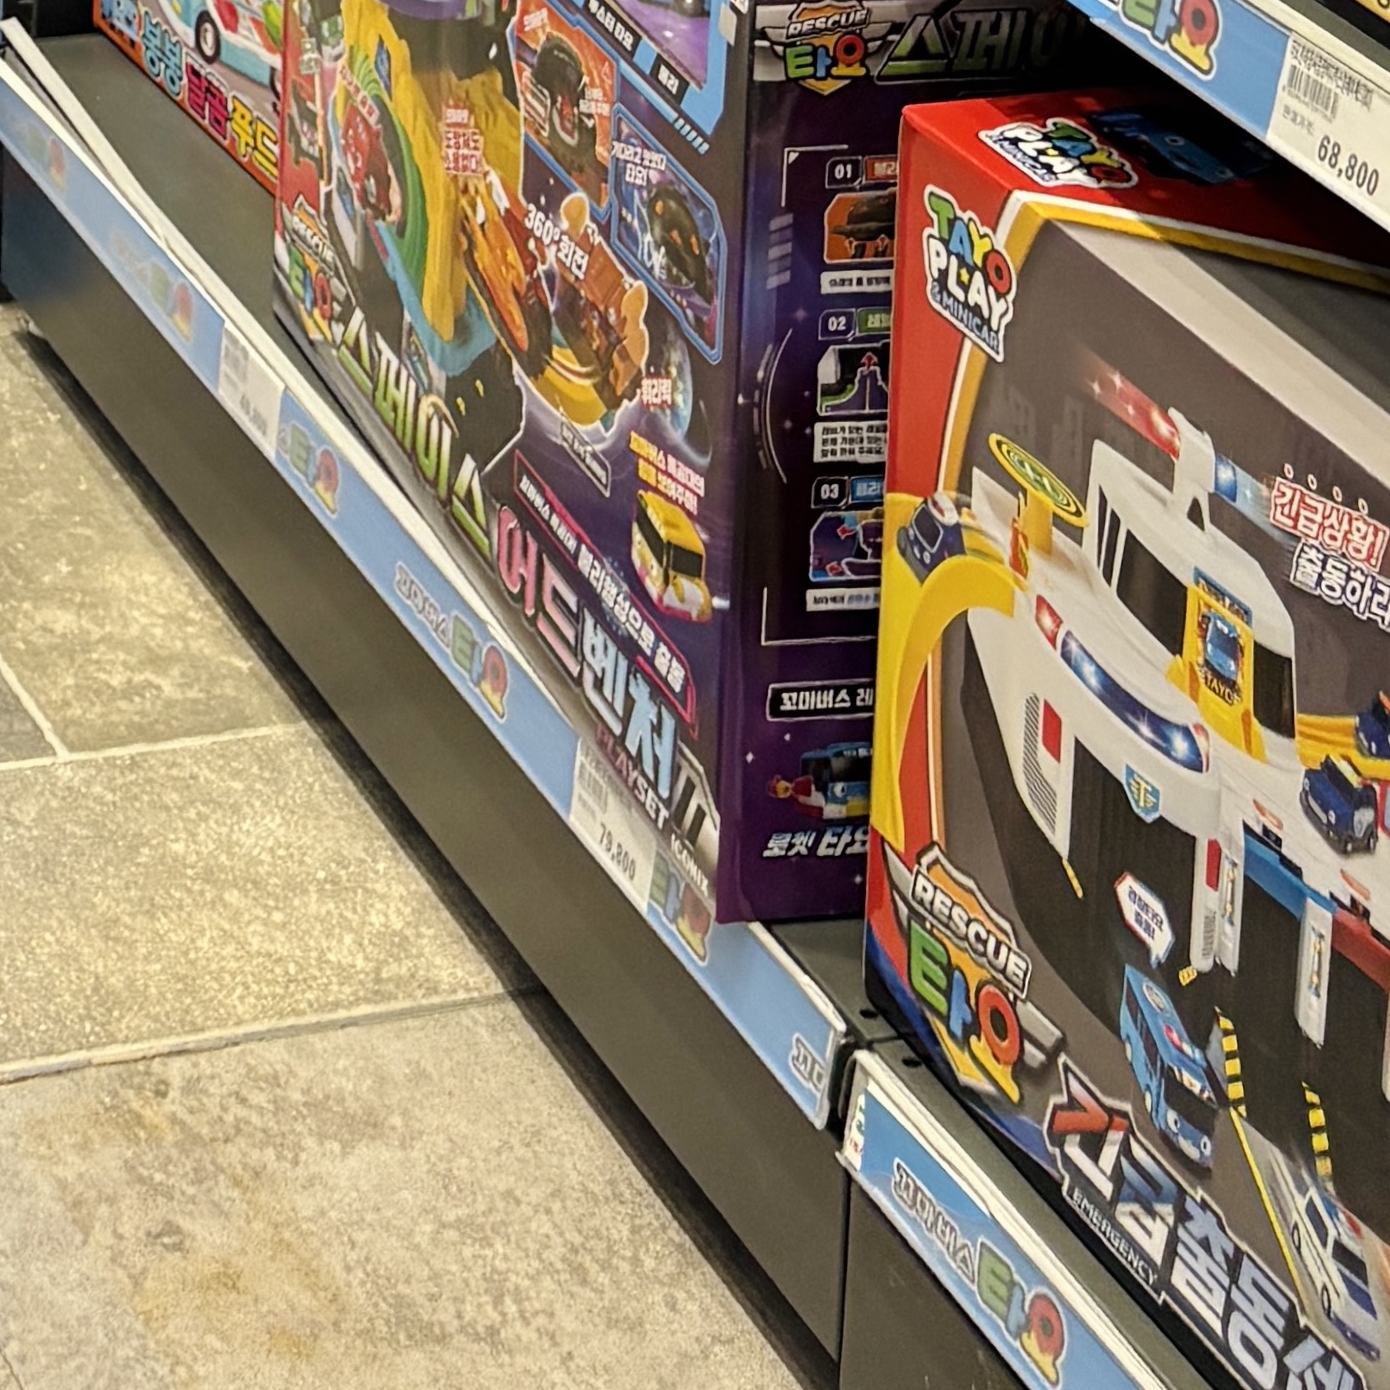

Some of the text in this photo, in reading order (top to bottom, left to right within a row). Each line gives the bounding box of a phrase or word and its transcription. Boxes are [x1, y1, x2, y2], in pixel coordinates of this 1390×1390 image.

[784, 32, 868, 84] 타요
[786, 5, 869, 39] RESCUE
[833, 162, 854, 181] 01
[1316, 131, 1381, 197] 68,800
[927, 189, 1014, 296] TAYO
[927, 239, 1014, 334] PLAY
[828, 312, 848, 332] 02
[942, 293, 1002, 352] MINICAR
[820, 481, 840, 501] 03
[1271, 474, 1388, 573] 긴급상황!
[337, 306, 493, 560] 스페이스
[496, 504, 679, 798] 어드벤처
[450, 610, 508, 720] 타요
[780, 691, 852, 713] 꼬마버스
[595, 722, 670, 831] PLAYSET
[911, 864, 1032, 998] RESCUE
[907, 917, 1023, 1103] 타요
[892, 1156, 1070, 1387] 꼬마버스 타요
[1070, 1183, 1160, 1290] EMERGENCY
